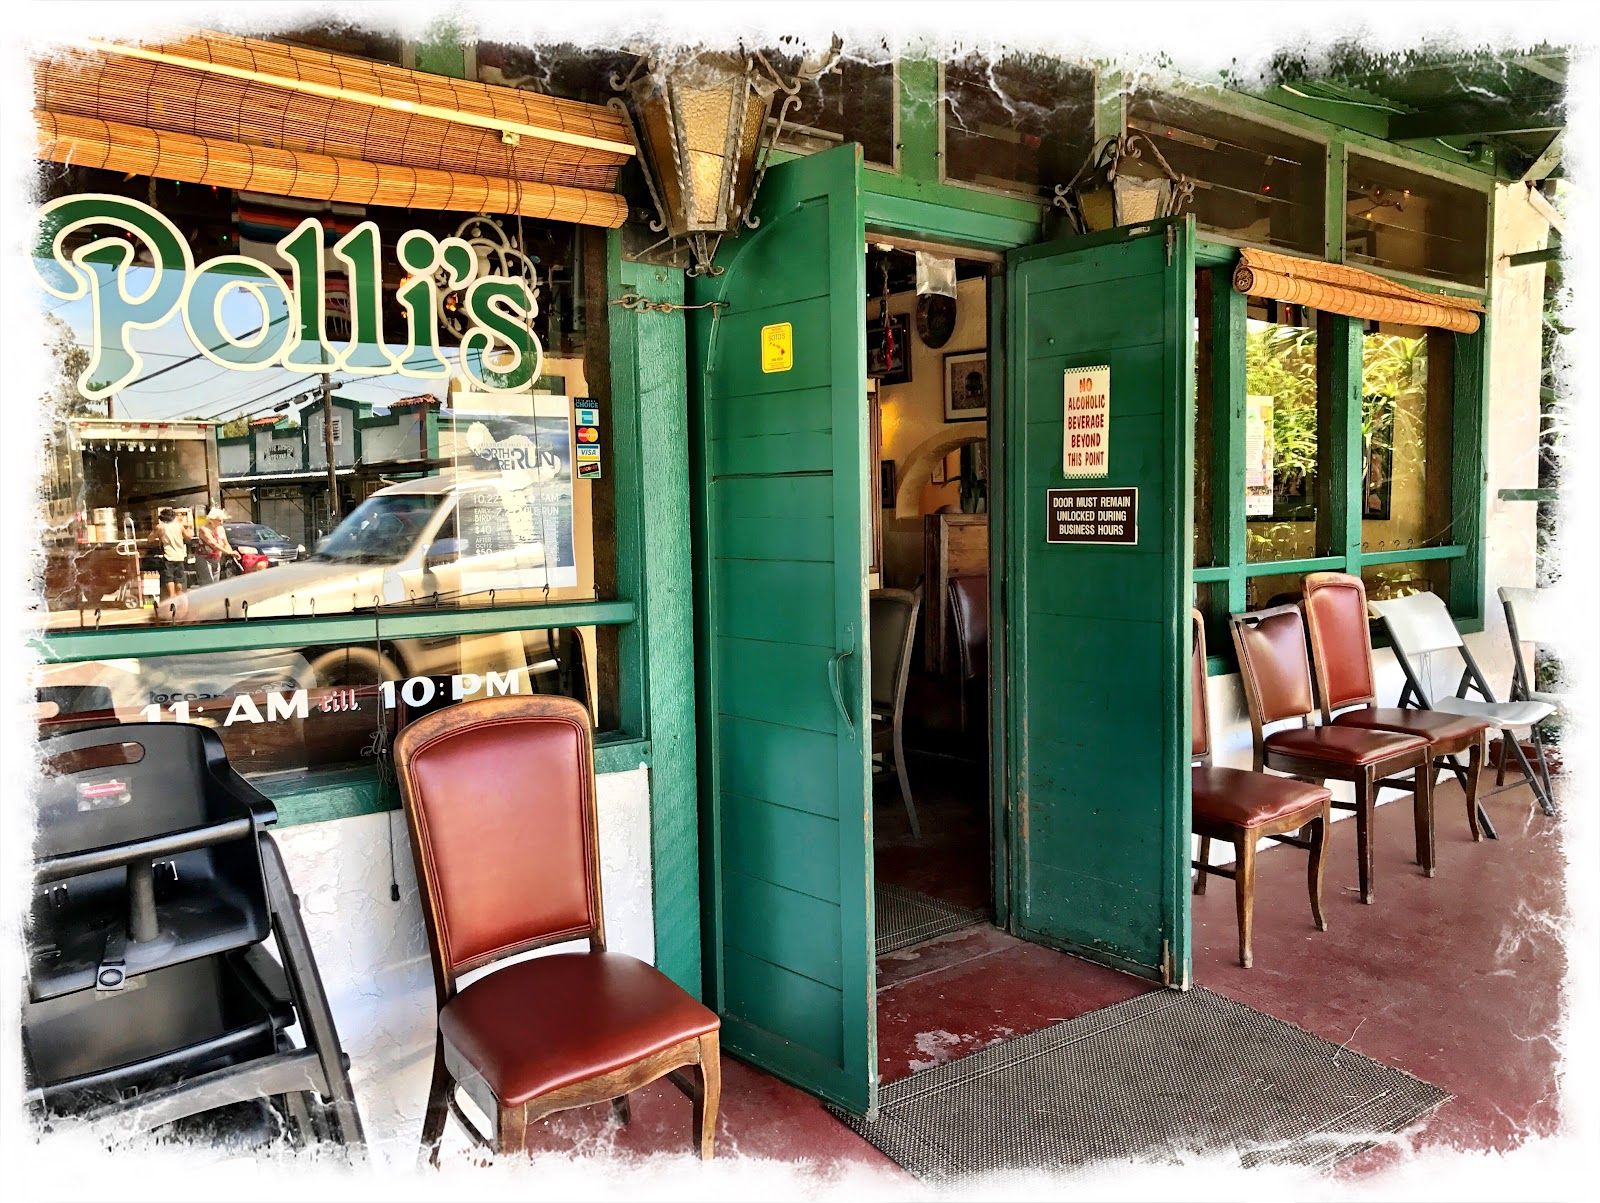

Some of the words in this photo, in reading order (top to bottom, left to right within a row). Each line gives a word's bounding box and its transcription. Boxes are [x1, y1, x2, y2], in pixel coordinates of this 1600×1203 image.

[29, 192, 543, 400] Polli's
[1079, 378, 1093, 392] NO
[575, 401, 599, 409] CHOICE
[1068, 394, 1105, 411] ALCOHOLIC
[1068, 414, 1104, 430] BEVERAGE
[1071, 433, 1101, 448] BEYOND
[511, 447, 556, 470] RUN
[1068, 452, 1082, 466] THIS
[1085, 451, 1104, 466] POINT
[1053, 497, 1074, 508] DOOR
[1076, 496, 1098, 508] MUST
[1100, 496, 1131, 508] REMAIN
[1056, 510, 1095, 522] UNLOCKED
[1097, 510, 1127, 522] DURING
[1059, 524, 1095, 535] BUSINESS
[1097, 524, 1124, 536] HOURS
[223, 688, 309, 727] AM
